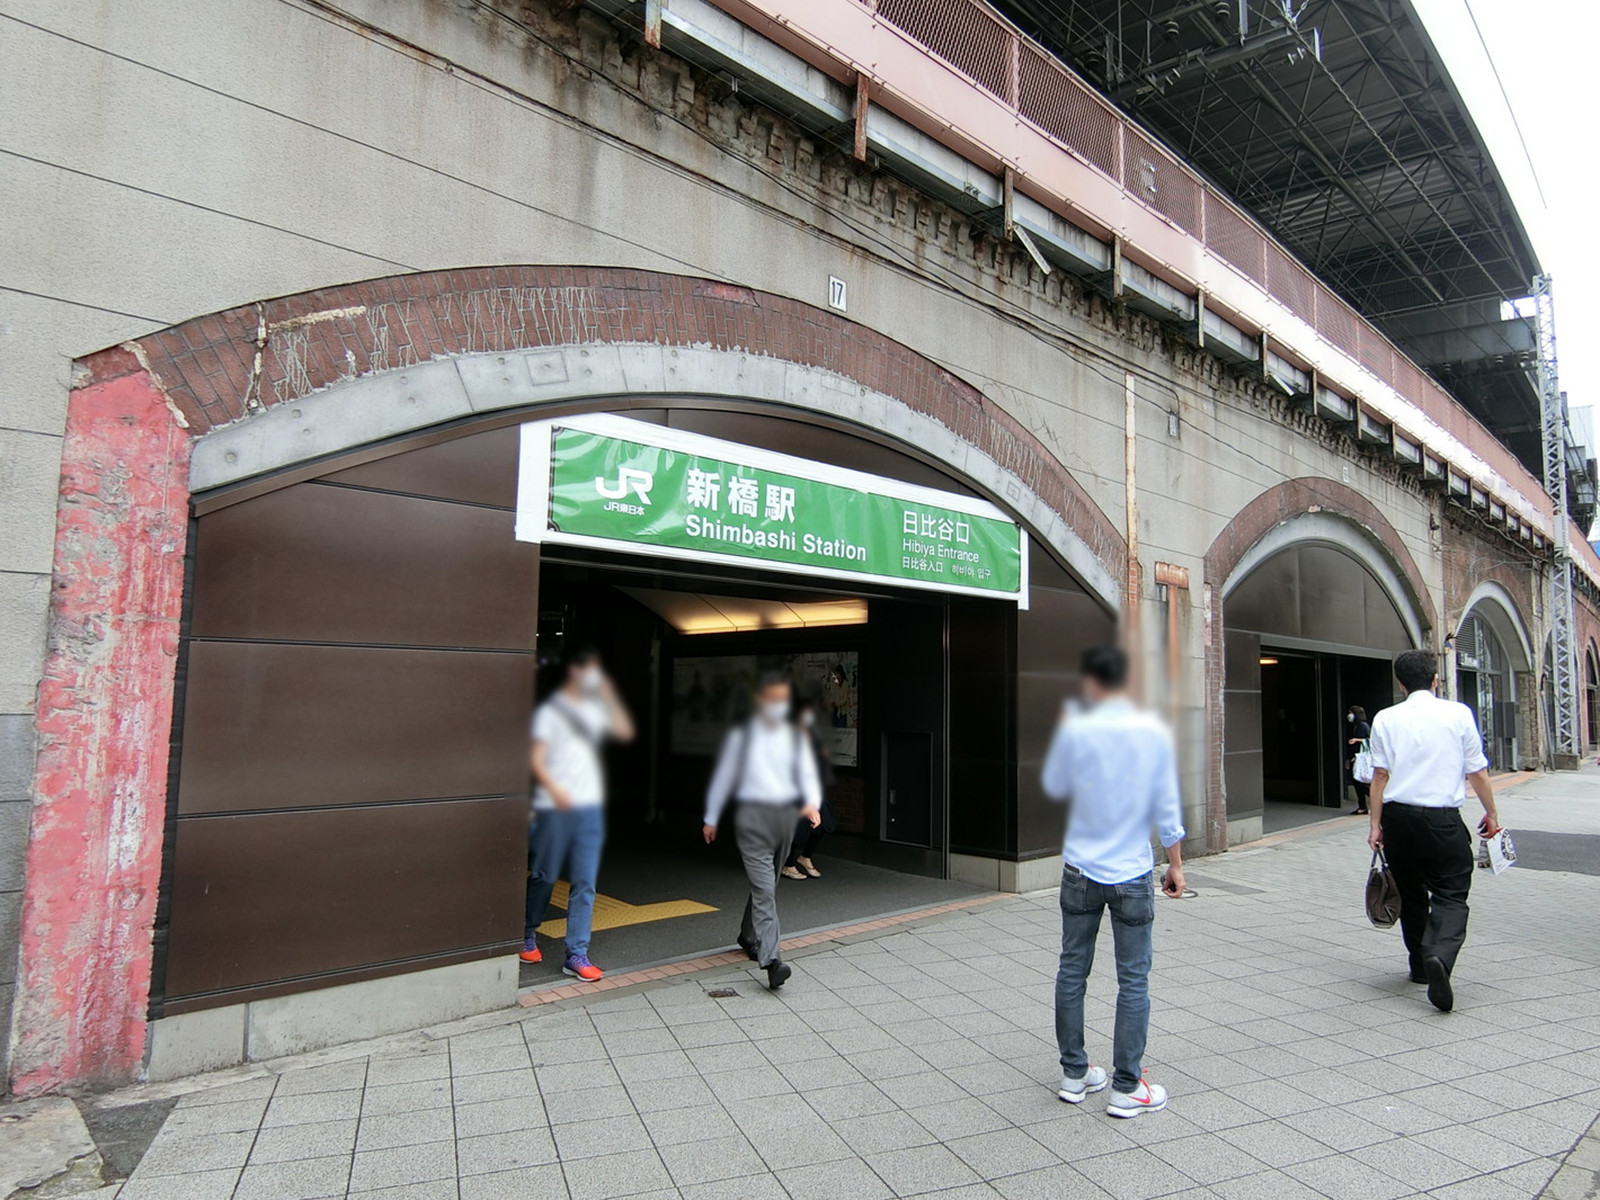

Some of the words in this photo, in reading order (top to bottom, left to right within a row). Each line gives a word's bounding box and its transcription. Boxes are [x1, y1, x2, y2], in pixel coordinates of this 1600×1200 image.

[832, 281, 843, 305] 17
[595, 466, 654, 505] JR
[686, 468, 796, 524] 新橋駅
[603, 501, 646, 516] JR東日本
[685, 514, 796, 551] Shimbashi
[802, 533, 867, 561] Station
[903, 510, 970, 544] 日比谷口
[902, 538, 936, 557] Hibiya
[937, 544, 980, 563] Entrance
[902, 556, 944, 573] 日比谷入口
